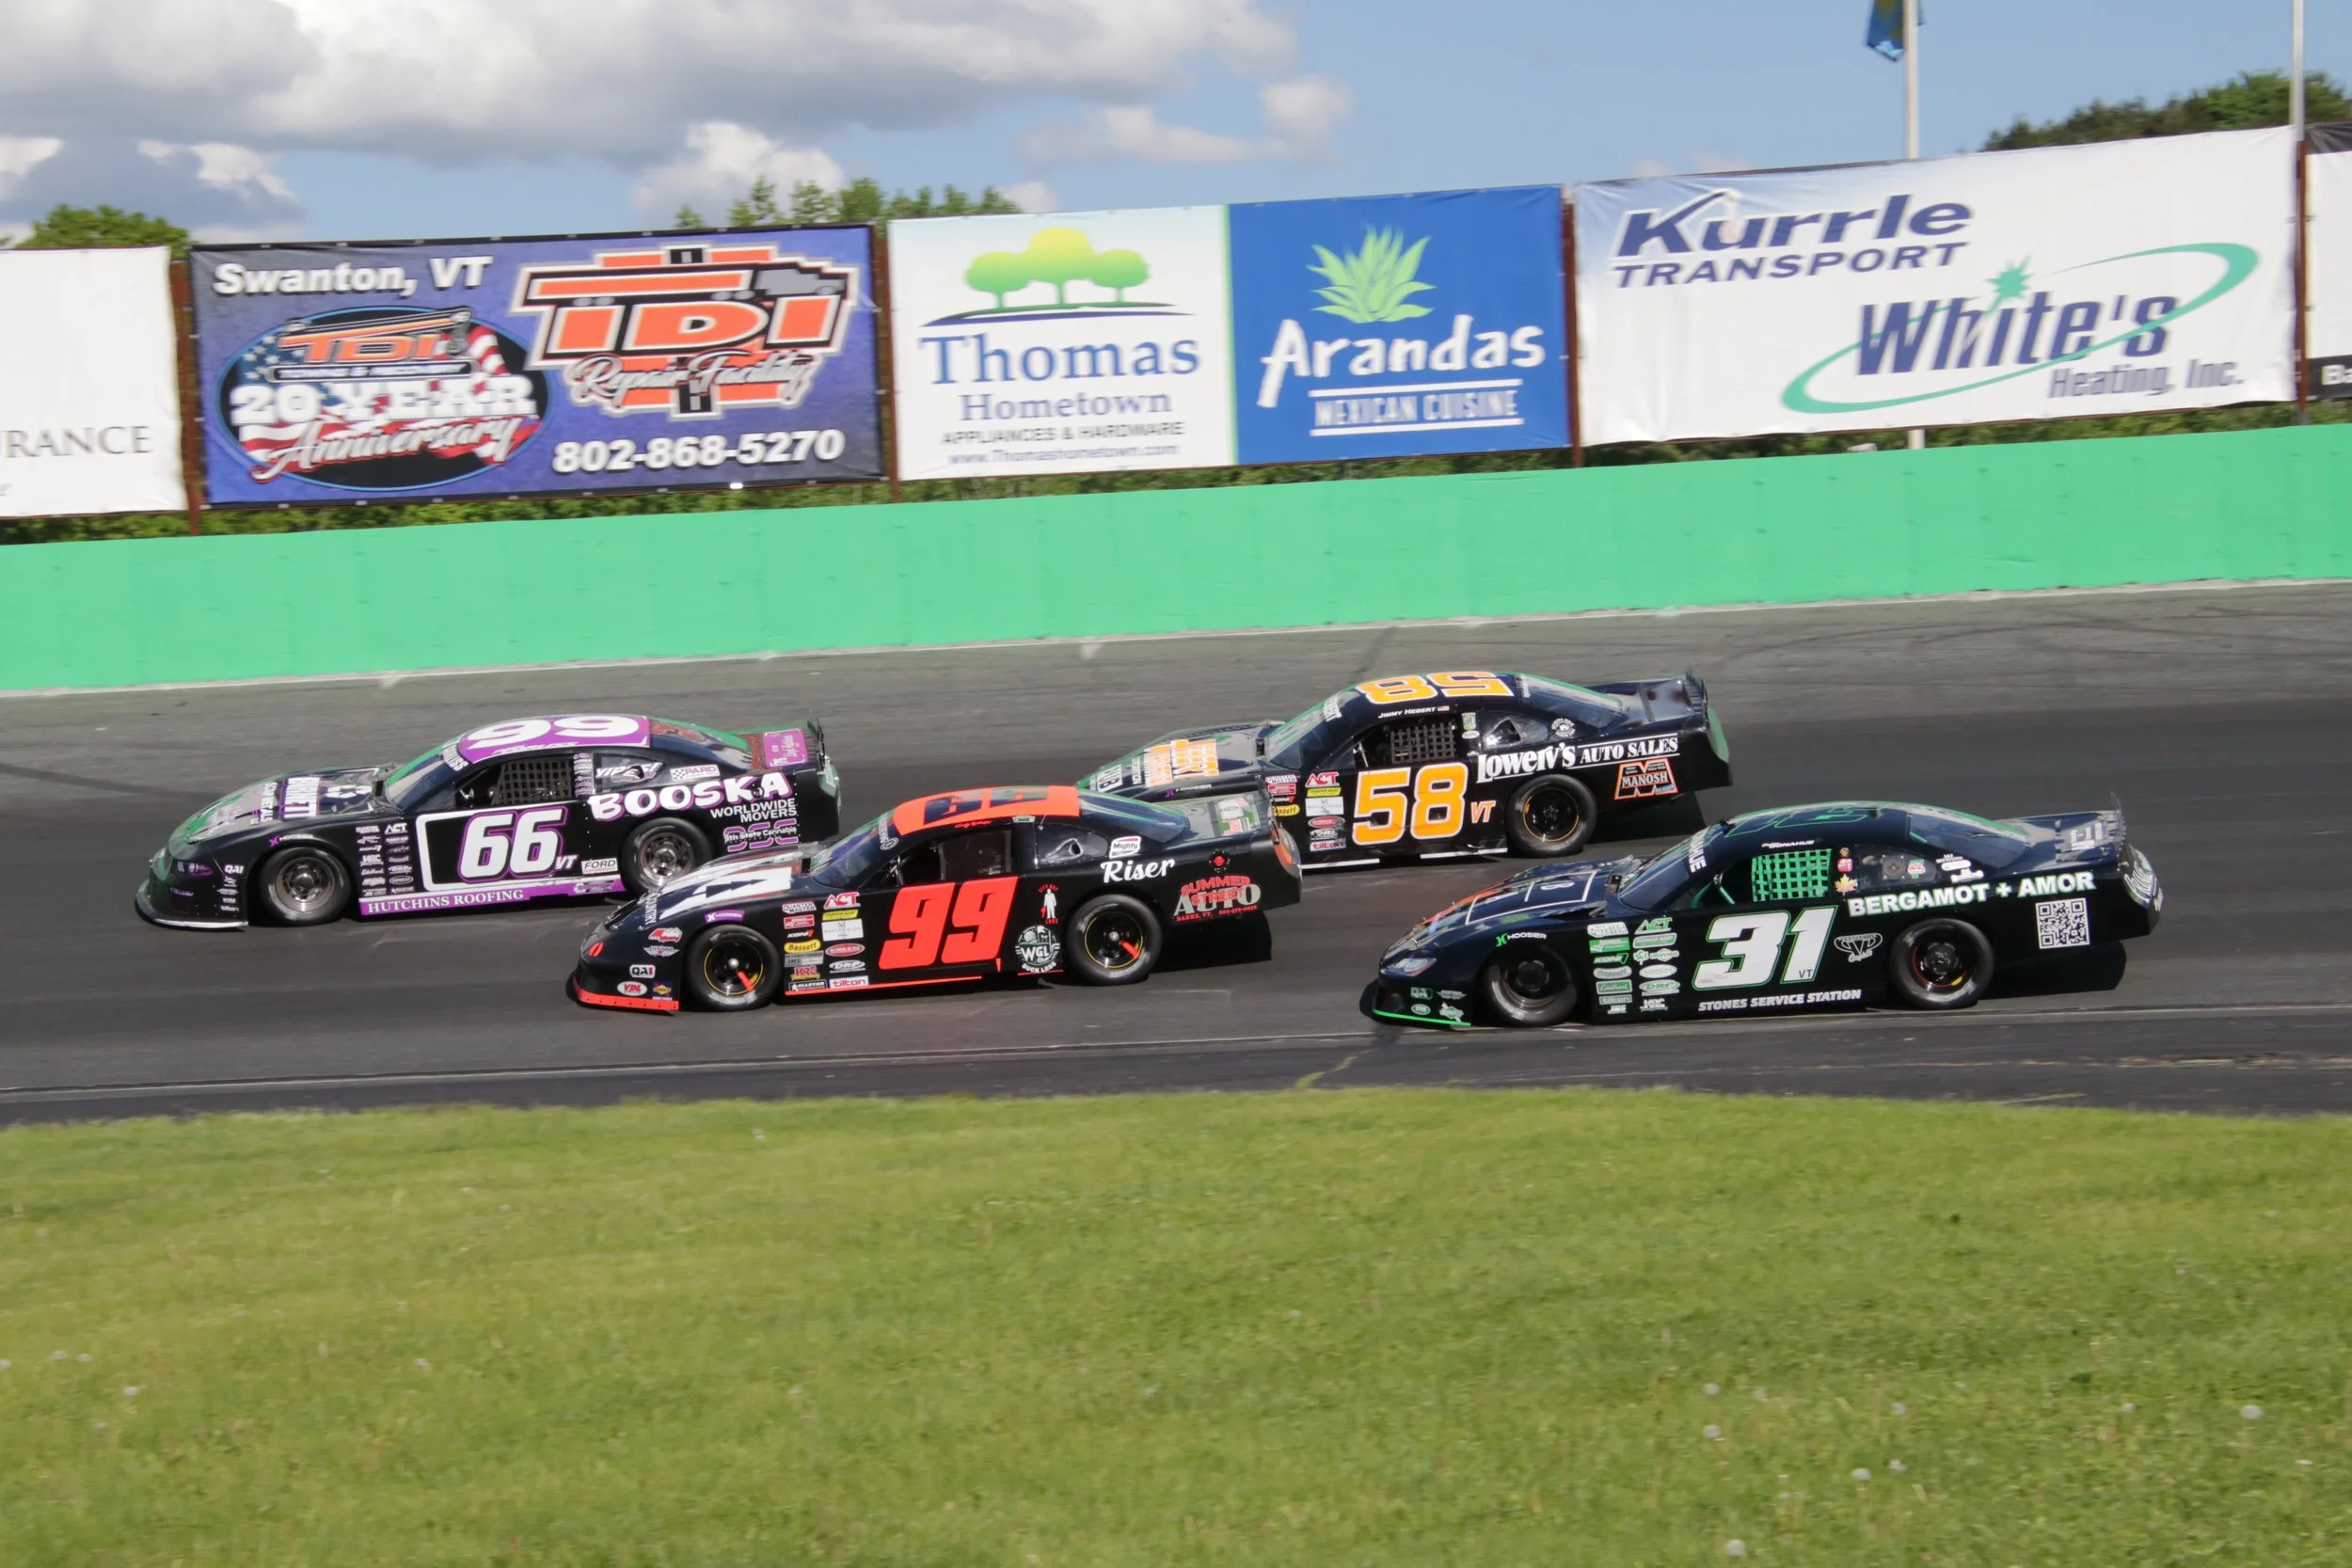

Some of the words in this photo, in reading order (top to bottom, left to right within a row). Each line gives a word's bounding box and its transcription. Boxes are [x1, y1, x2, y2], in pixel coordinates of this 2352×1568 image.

[1616, 192, 1972, 258] Kurrle
[214, 263, 419, 297] Swanton,
[430, 256, 494, 289] VT
[1613, 242, 1968, 288] TRANSPORT
[527, 270, 843, 354] TDI
[1857, 292, 2180, 376] White's
[918, 333, 1200, 384] Thomas
[1257, 314, 1547, 408] Arandas
[2185, 359, 2245, 389] Inc.
[230, 382, 322, 423] 20
[325, 376, 537, 420] YEAR
[959, 391, 1173, 421] Hometown
[1314, 396, 1418, 426] MEXICAN
[1423, 389, 1518, 420] CUISINE
[0, 425, 151, 458] RANCE
[941, 429, 1057, 445] APPLIANCES
[1061, 427, 1075, 440] &
[1078, 421, 1186, 439] HARDWARE
[251, 418, 523, 482] Anniversary
[552, 429, 846, 474] 802-868-5270
[1378, 709, 1403, 719] JIMMY
[1405, 706, 1437, 715] HEBERT
[1580, 743, 1625, 766] AUTO
[1627, 736, 1679, 758] SALES
[1306, 771, 1340, 787] ACT
[1621, 771, 1668, 787] MANOSH
[588, 772, 793, 819] BOOSKA
[710, 798, 796, 818] WORLDWIDE
[1353, 763, 1469, 845] 58
[740, 807, 798, 823] MOVERS
[1470, 800, 1497, 824] VT
[384, 822, 408, 834] ACT
[739, 832, 761, 840] State
[762, 827, 798, 837] Cannabis
[459, 806, 566, 881] 66
[555, 855, 578, 870] VT
[584, 860, 616, 869] FORD
[1101, 859, 1175, 883] Riser
[1181, 875, 1250, 896] SUMMER
[1191, 888, 1245, 907] STREET
[1848, 883, 1991, 917] BERGAMOT
[2017, 871, 2098, 898] AMOR
[368, 896, 449, 914] HUTCHINS
[454, 890, 525, 908] ROOFING
[824, 893, 860, 909] ACT
[1173, 884, 1261, 916] AUTO
[879, 876, 1019, 970] 99
[1635, 918, 1673, 934] ACT
[1021, 945, 1050, 961] WGL
[1693, 907, 1836, 990] 31
[631, 967, 654, 975] QA1
[833, 979, 866, 988] tilton
[1799, 969, 1813, 978] VT
[1698, 1000, 1747, 1012] STONES
[1750, 993, 1804, 1007] SERVICE
[1806, 989, 1862, 1004] STATION
